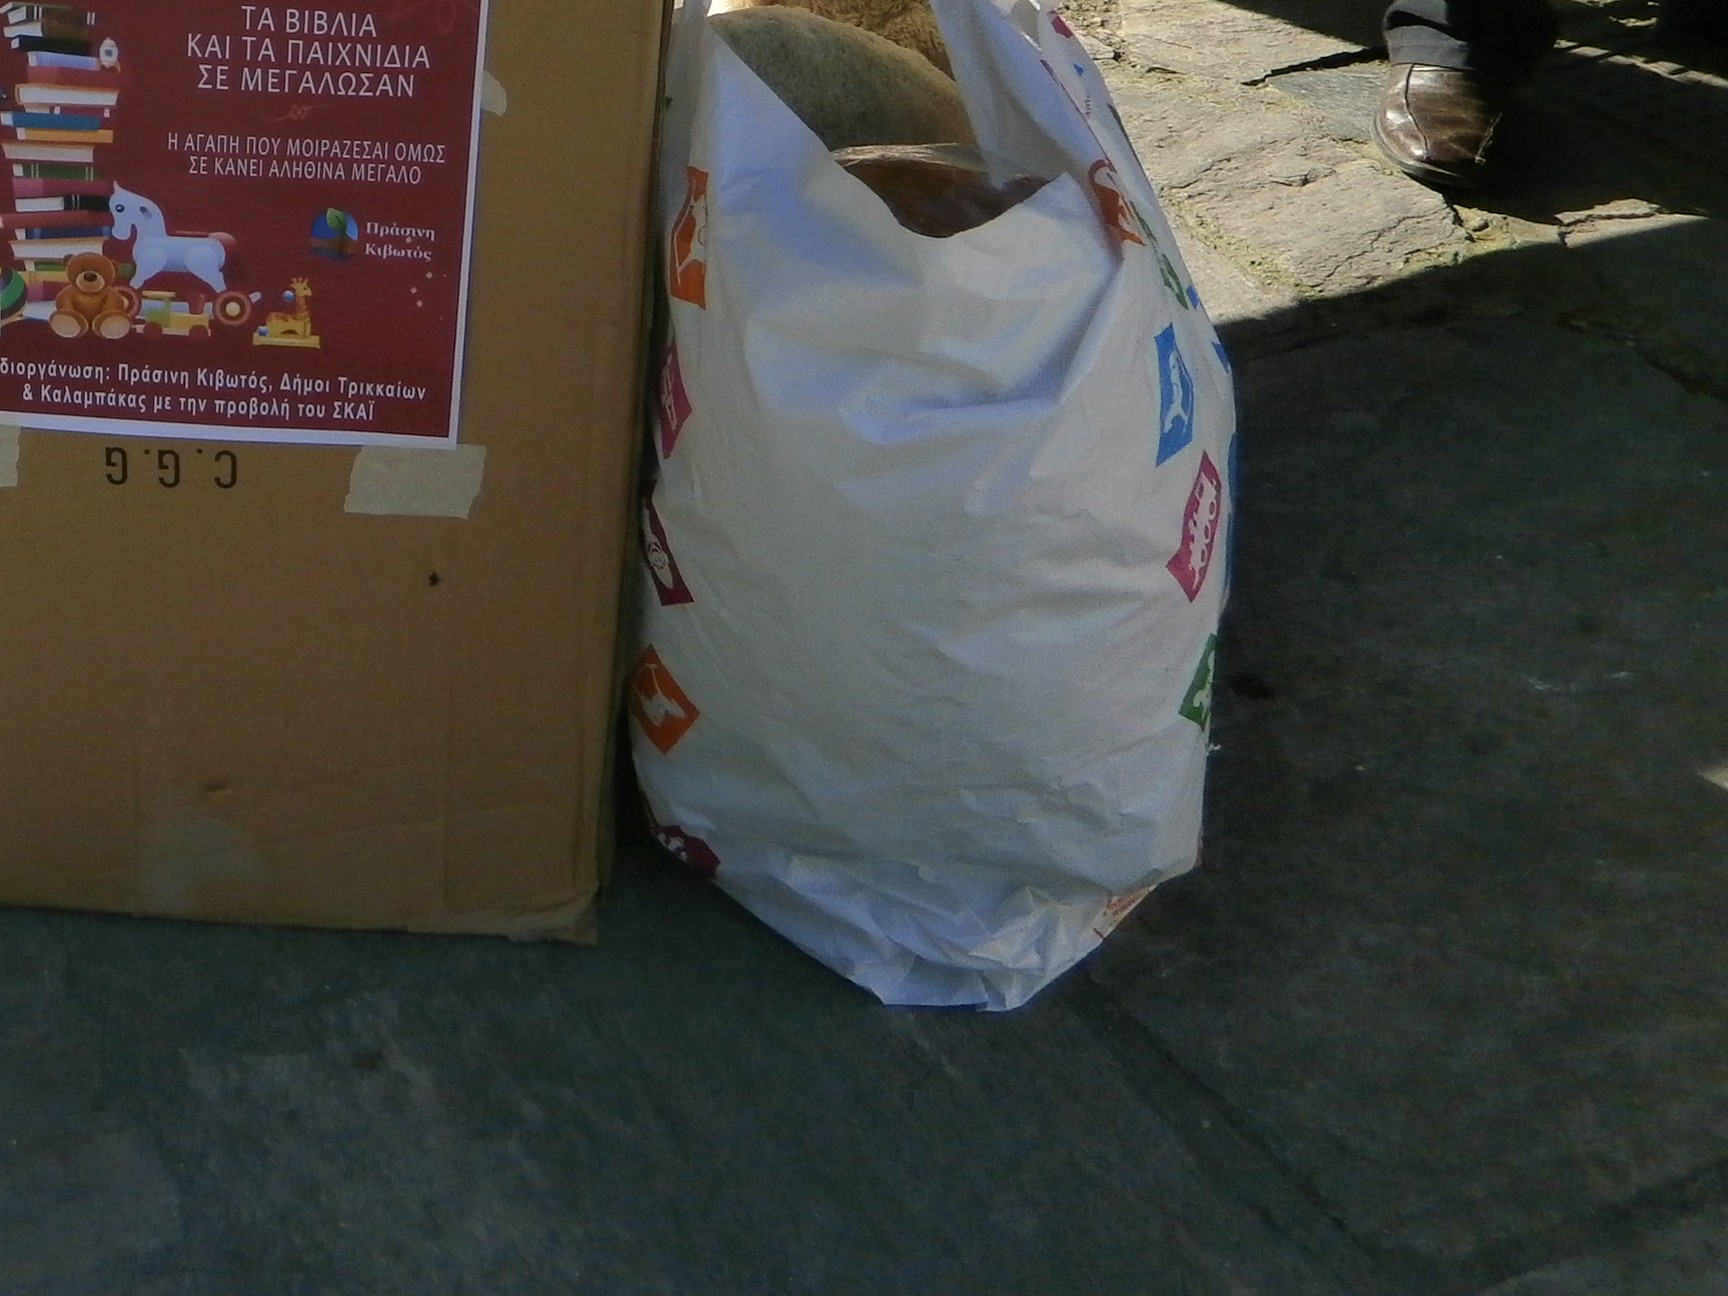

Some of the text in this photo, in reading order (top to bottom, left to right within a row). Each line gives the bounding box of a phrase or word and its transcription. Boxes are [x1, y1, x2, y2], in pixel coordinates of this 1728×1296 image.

[240, 5, 376, 37] ΤΑ ΒΙΒΛΙΑ
[187, 32, 429, 68] ΚΑΙ ΤΑ ΠΑΙΧΝΙΔΙΑ
[197, 64, 413, 97] ΣΕ ΜΕΓΑΛΩΣΑΝ
[168, 132, 445, 163] Η ΑΓΑΠΗ ΠΟΥ ΜΟΙΡΑΖΕΣΑΙ ΟΜΩΣ
[188, 155, 421, 184] ΣΕ ΚΑΝΕΙ ΑΛΗΘΙΝΑ ΜΕΓΑΛΟ
[366, 221, 434, 243] Πράσινη
[118, 363, 188, 389] Πράσινη
[196, 367, 272, 393] Κιβωτός,
[279, 372, 329, 395] Δήμοι
[337, 376, 425, 403] Τρικκαίων
[22, 382, 33, 400] &
[41, 383, 146, 412] Καλαμπάκας
[153, 395, 171, 413] με
[178, 397, 206, 415] την
[213, 396, 289, 420] προβολή
[297, 403, 325, 417] του
